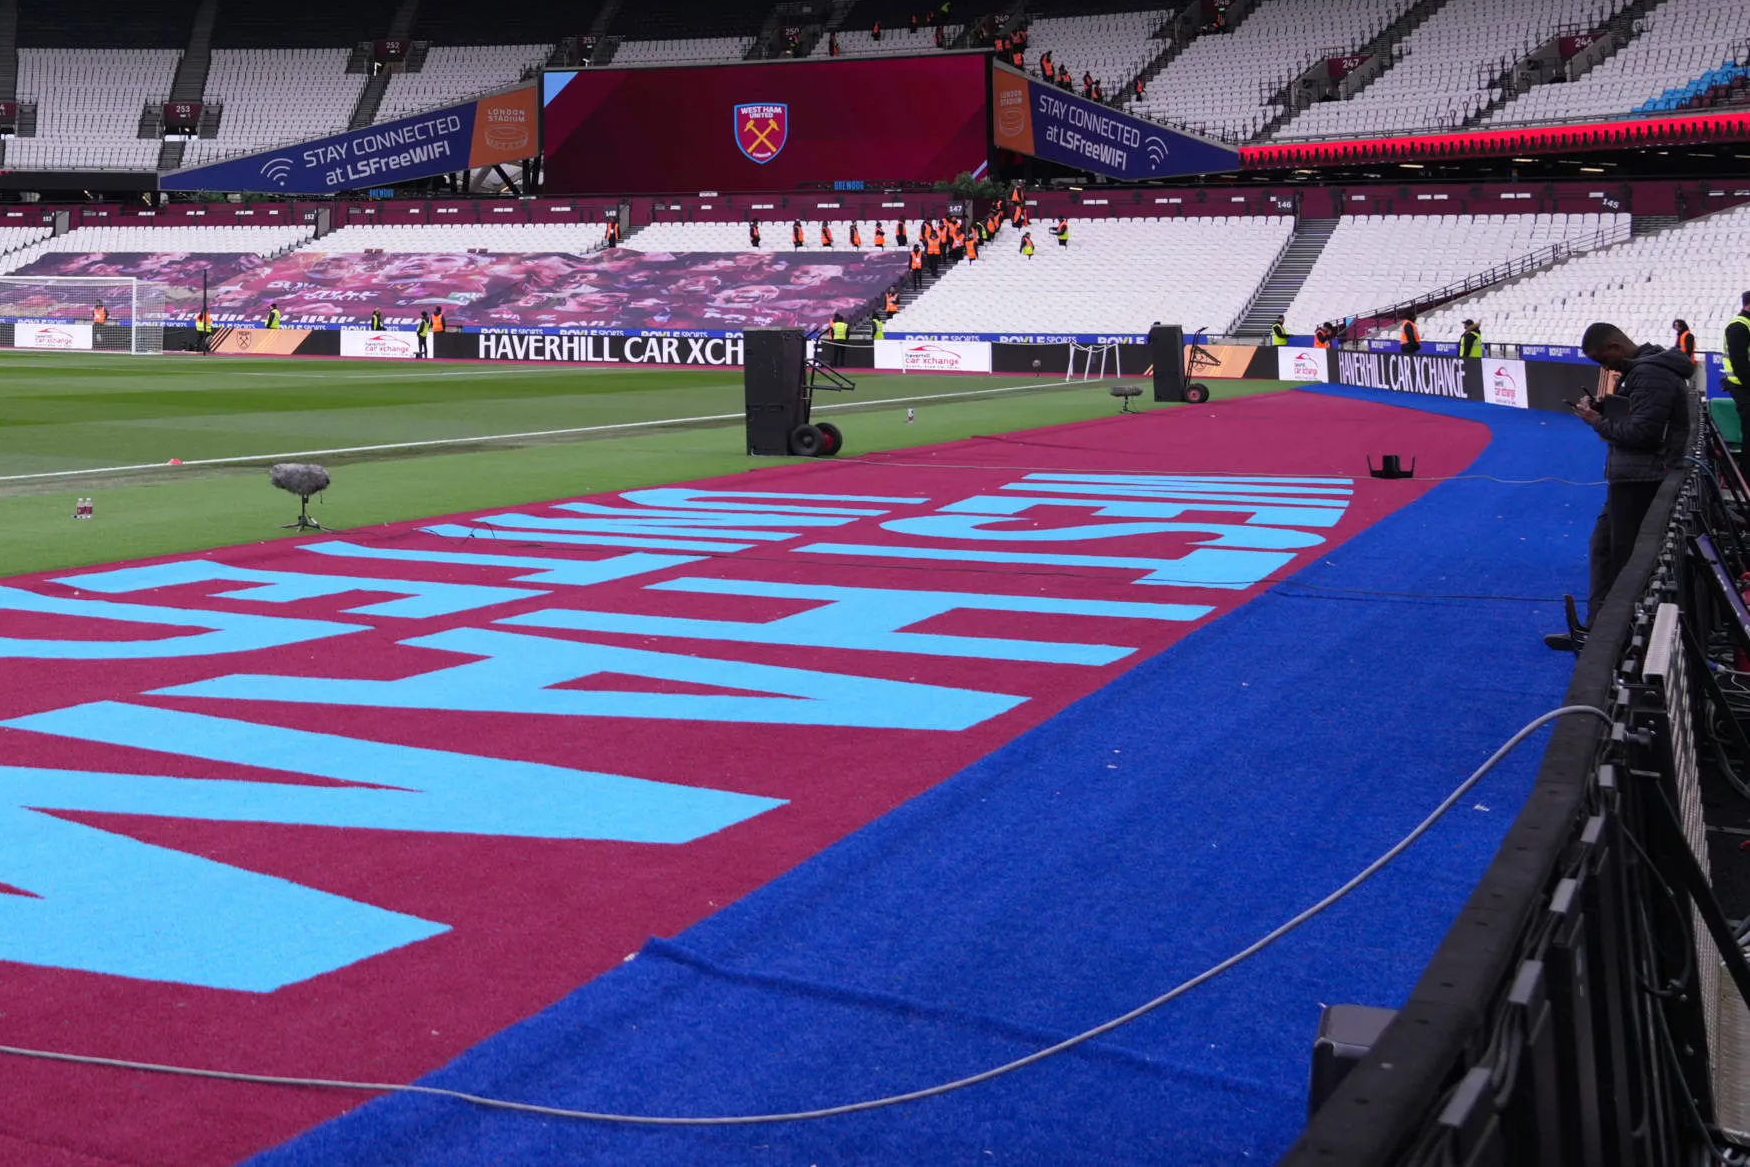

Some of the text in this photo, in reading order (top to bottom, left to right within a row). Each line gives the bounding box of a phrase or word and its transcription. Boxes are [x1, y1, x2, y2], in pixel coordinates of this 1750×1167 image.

[1342, 58, 1359, 69] 247
[741, 106, 782, 114] WEST HAM
[1039, 94, 1140, 148] STAY CONNECTED
[303, 115, 460, 167] STAY CONNECTED
[1046, 125, 1127, 170] at LSFreeWIFI
[326, 141, 450, 185] at LSFreeWIFI
[1603, 198, 1620, 209] 145
[478, 335, 619, 362] HAVERHILL
[624, 337, 681, 364] CAR
[1371, 340, 1383, 348] BOYLE
[1436, 343, 1448, 352] BOYLE
[1522, 346, 1536, 355] BOYLE
[1549, 348, 1562, 356] BOYLE
[923, 357, 959, 366] xchange
[1338, 352, 1468, 398] HAVERHILL CAR XCHANGE
[791, 471, 1355, 588] WEST
